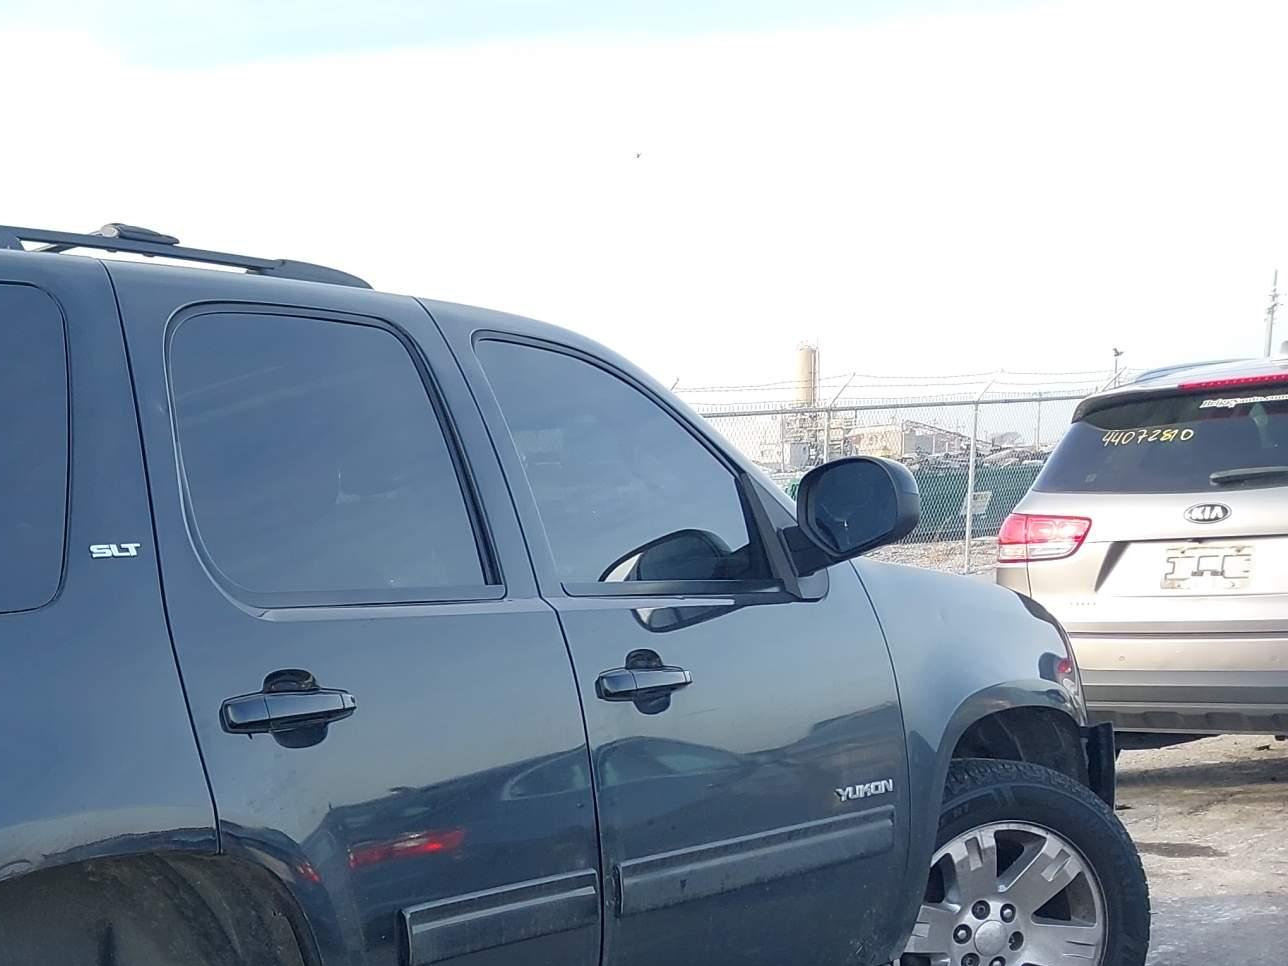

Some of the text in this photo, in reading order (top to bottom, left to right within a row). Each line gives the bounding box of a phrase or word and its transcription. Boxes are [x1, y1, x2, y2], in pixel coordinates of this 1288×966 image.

[1189, 505, 1225, 520] KIA
[89, 542, 141, 558] SLT
[834, 778, 893, 802] YUKON
